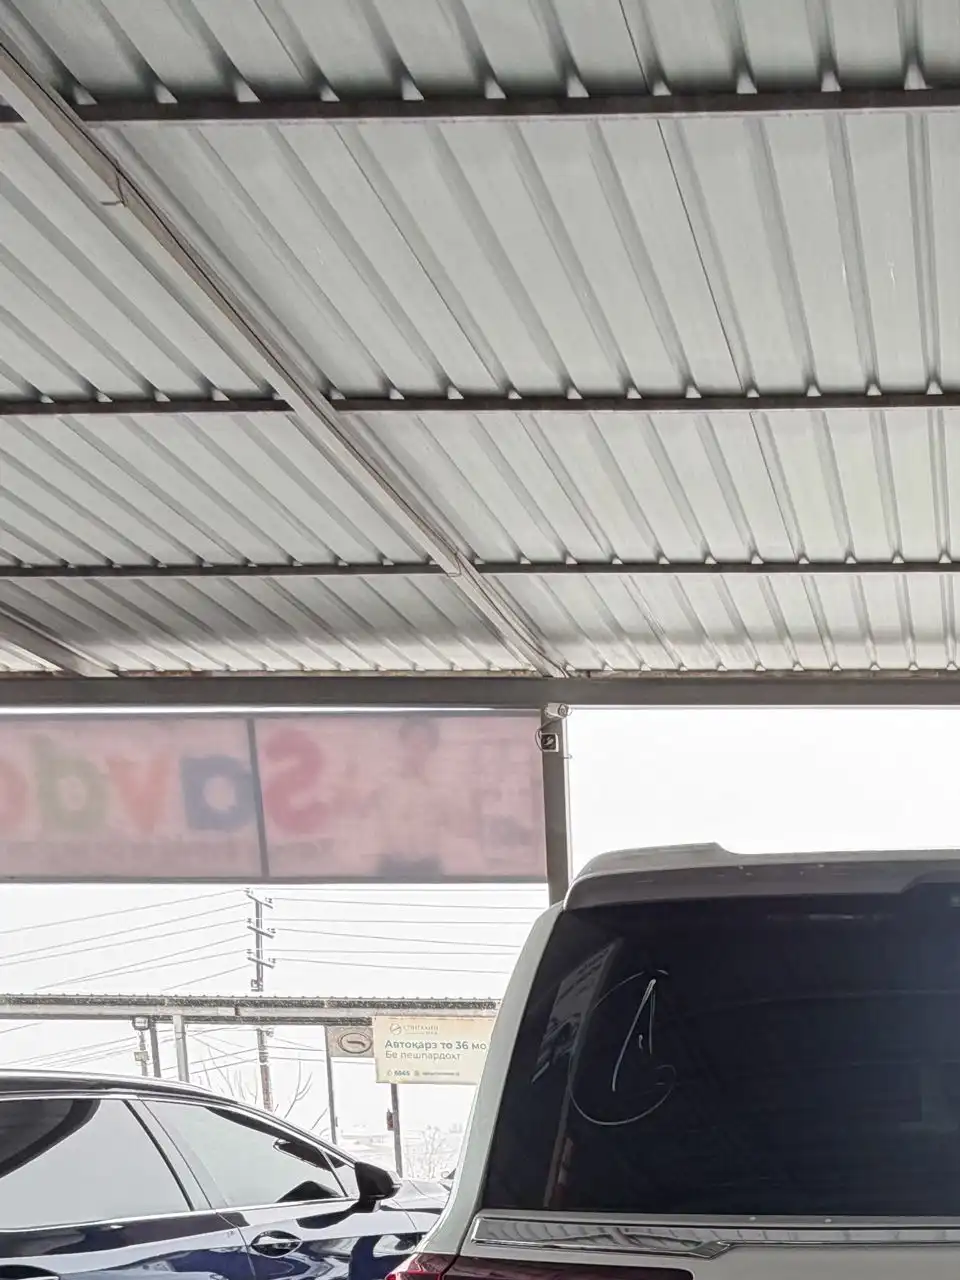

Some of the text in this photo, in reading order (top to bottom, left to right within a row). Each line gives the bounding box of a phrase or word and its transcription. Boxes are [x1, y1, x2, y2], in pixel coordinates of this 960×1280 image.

[440, 1042, 453, 1050] то
[455, 1041, 469, 1050] 36
[385, 1050, 398, 1059] Бе
